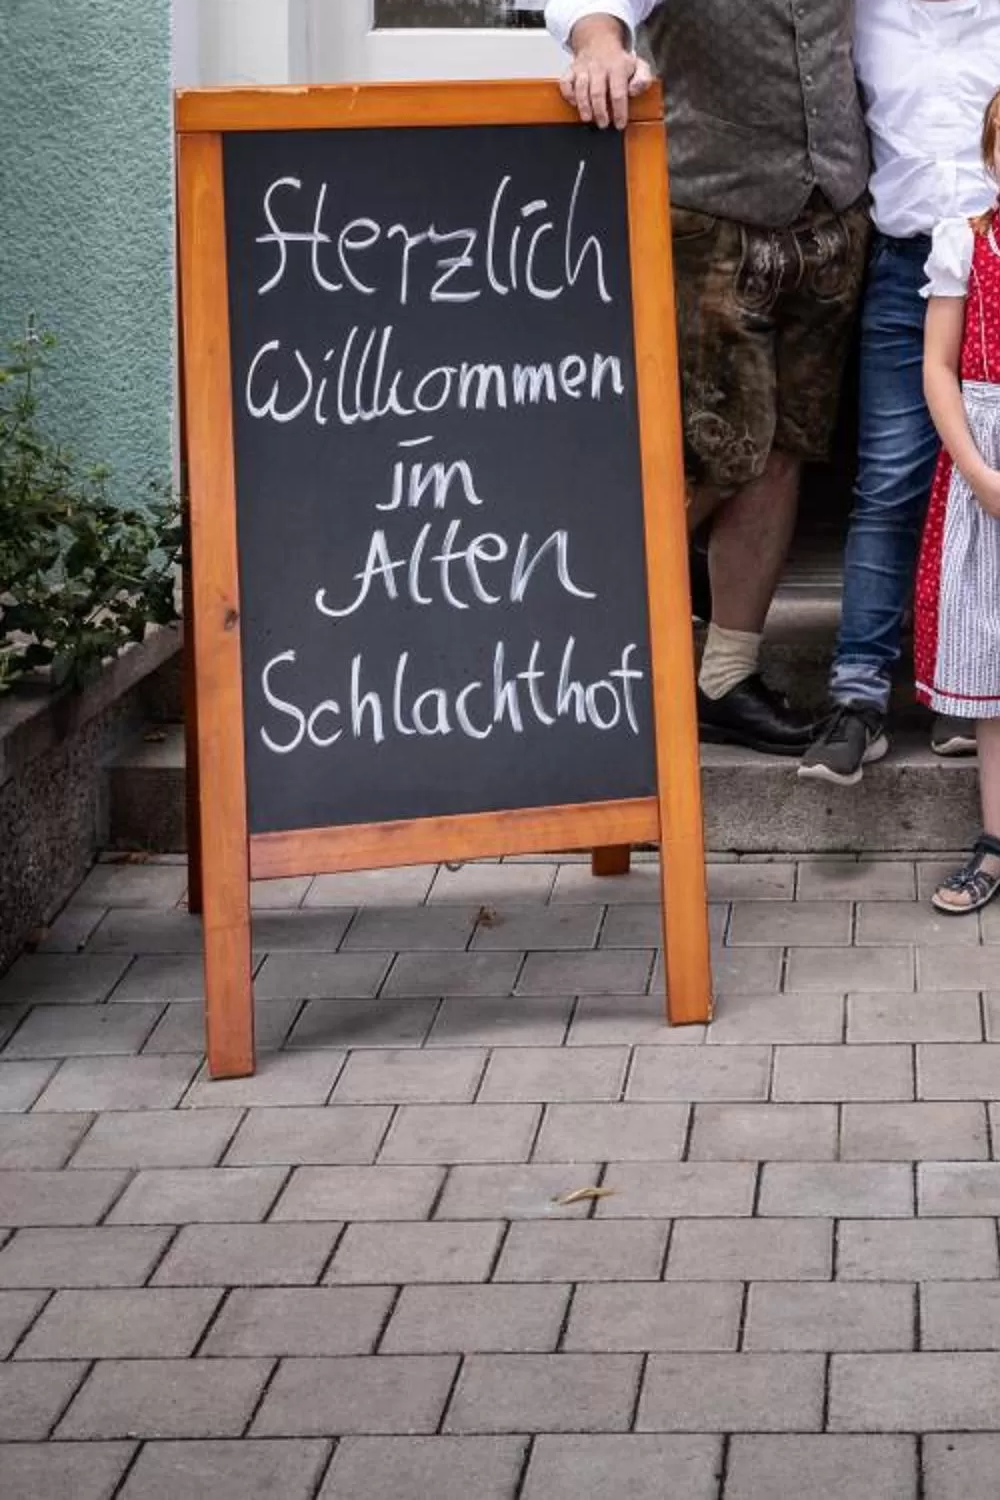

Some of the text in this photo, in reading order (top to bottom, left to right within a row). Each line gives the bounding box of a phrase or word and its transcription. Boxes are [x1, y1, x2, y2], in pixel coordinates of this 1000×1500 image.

[255, 160, 613, 305] Herzlich
[245, 324, 625, 426] Willkommen
[374, 435, 484, 512] im
[314, 518, 598, 618] Alten
[259, 635, 644, 755] Schlachthof
